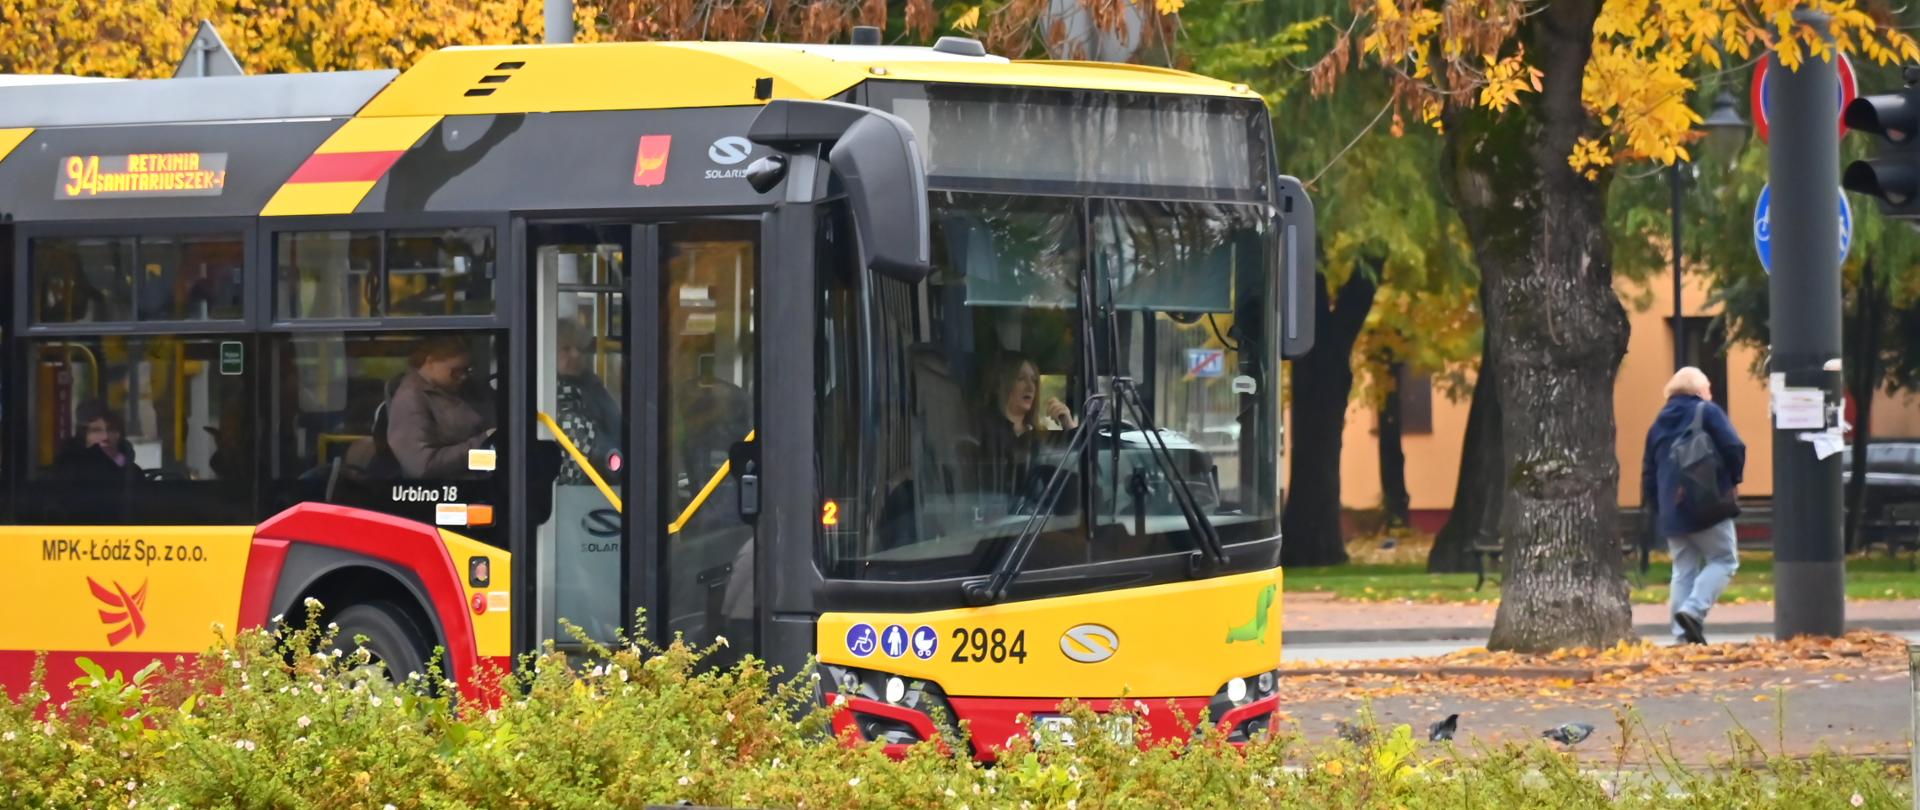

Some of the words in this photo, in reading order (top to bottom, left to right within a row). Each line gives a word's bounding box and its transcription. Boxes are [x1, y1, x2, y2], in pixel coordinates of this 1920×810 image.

[128, 153, 200, 172] RETKINIA
[704, 168, 748, 179] SOLARIS
[65, 155, 99, 196] 94
[392, 485, 439, 502] Urbino
[442, 486, 458, 502] 18
[822, 501, 837, 525] 2
[42, 539, 131, 561] MPK-Łódź
[134, 539, 161, 566] Sp.
[164, 545, 173, 561] z
[176, 545, 207, 561] o.o.
[951, 627, 1027, 664] 2984
